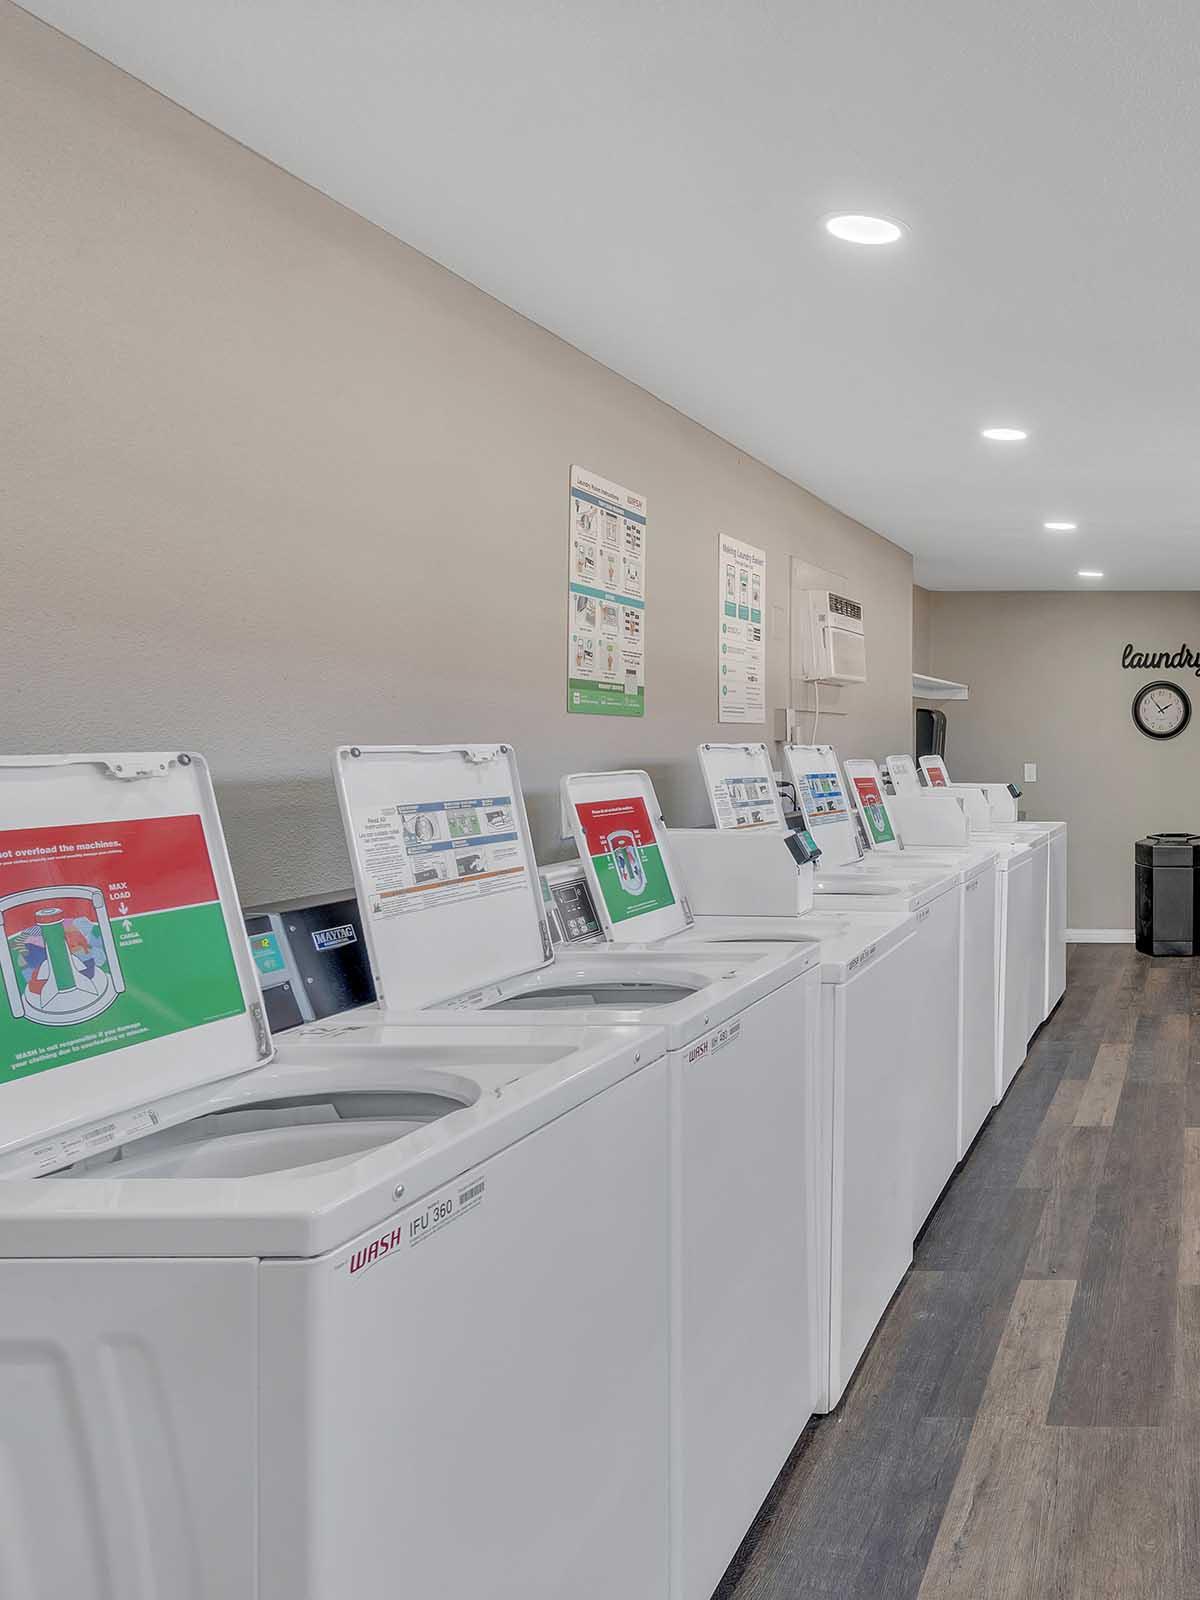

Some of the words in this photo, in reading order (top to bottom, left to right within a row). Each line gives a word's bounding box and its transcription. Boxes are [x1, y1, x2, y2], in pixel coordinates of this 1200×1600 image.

[16, 845, 57, 856] overload
[59, 844, 75, 852] the
[76, 840, 122, 850] machines.
[108, 882, 128, 891] MAX
[109, 891, 131, 901] LOAD
[315, 926, 353, 944] MAYTAG
[15, 1048, 38, 1060] WASH
[46, 1043, 59, 1051] not
[689, 1041, 708, 1062] WASH
[350, 1227, 401, 1273] WASH
[409, 1211, 429, 1238] IFU
[433, 1199, 453, 1222] 360
